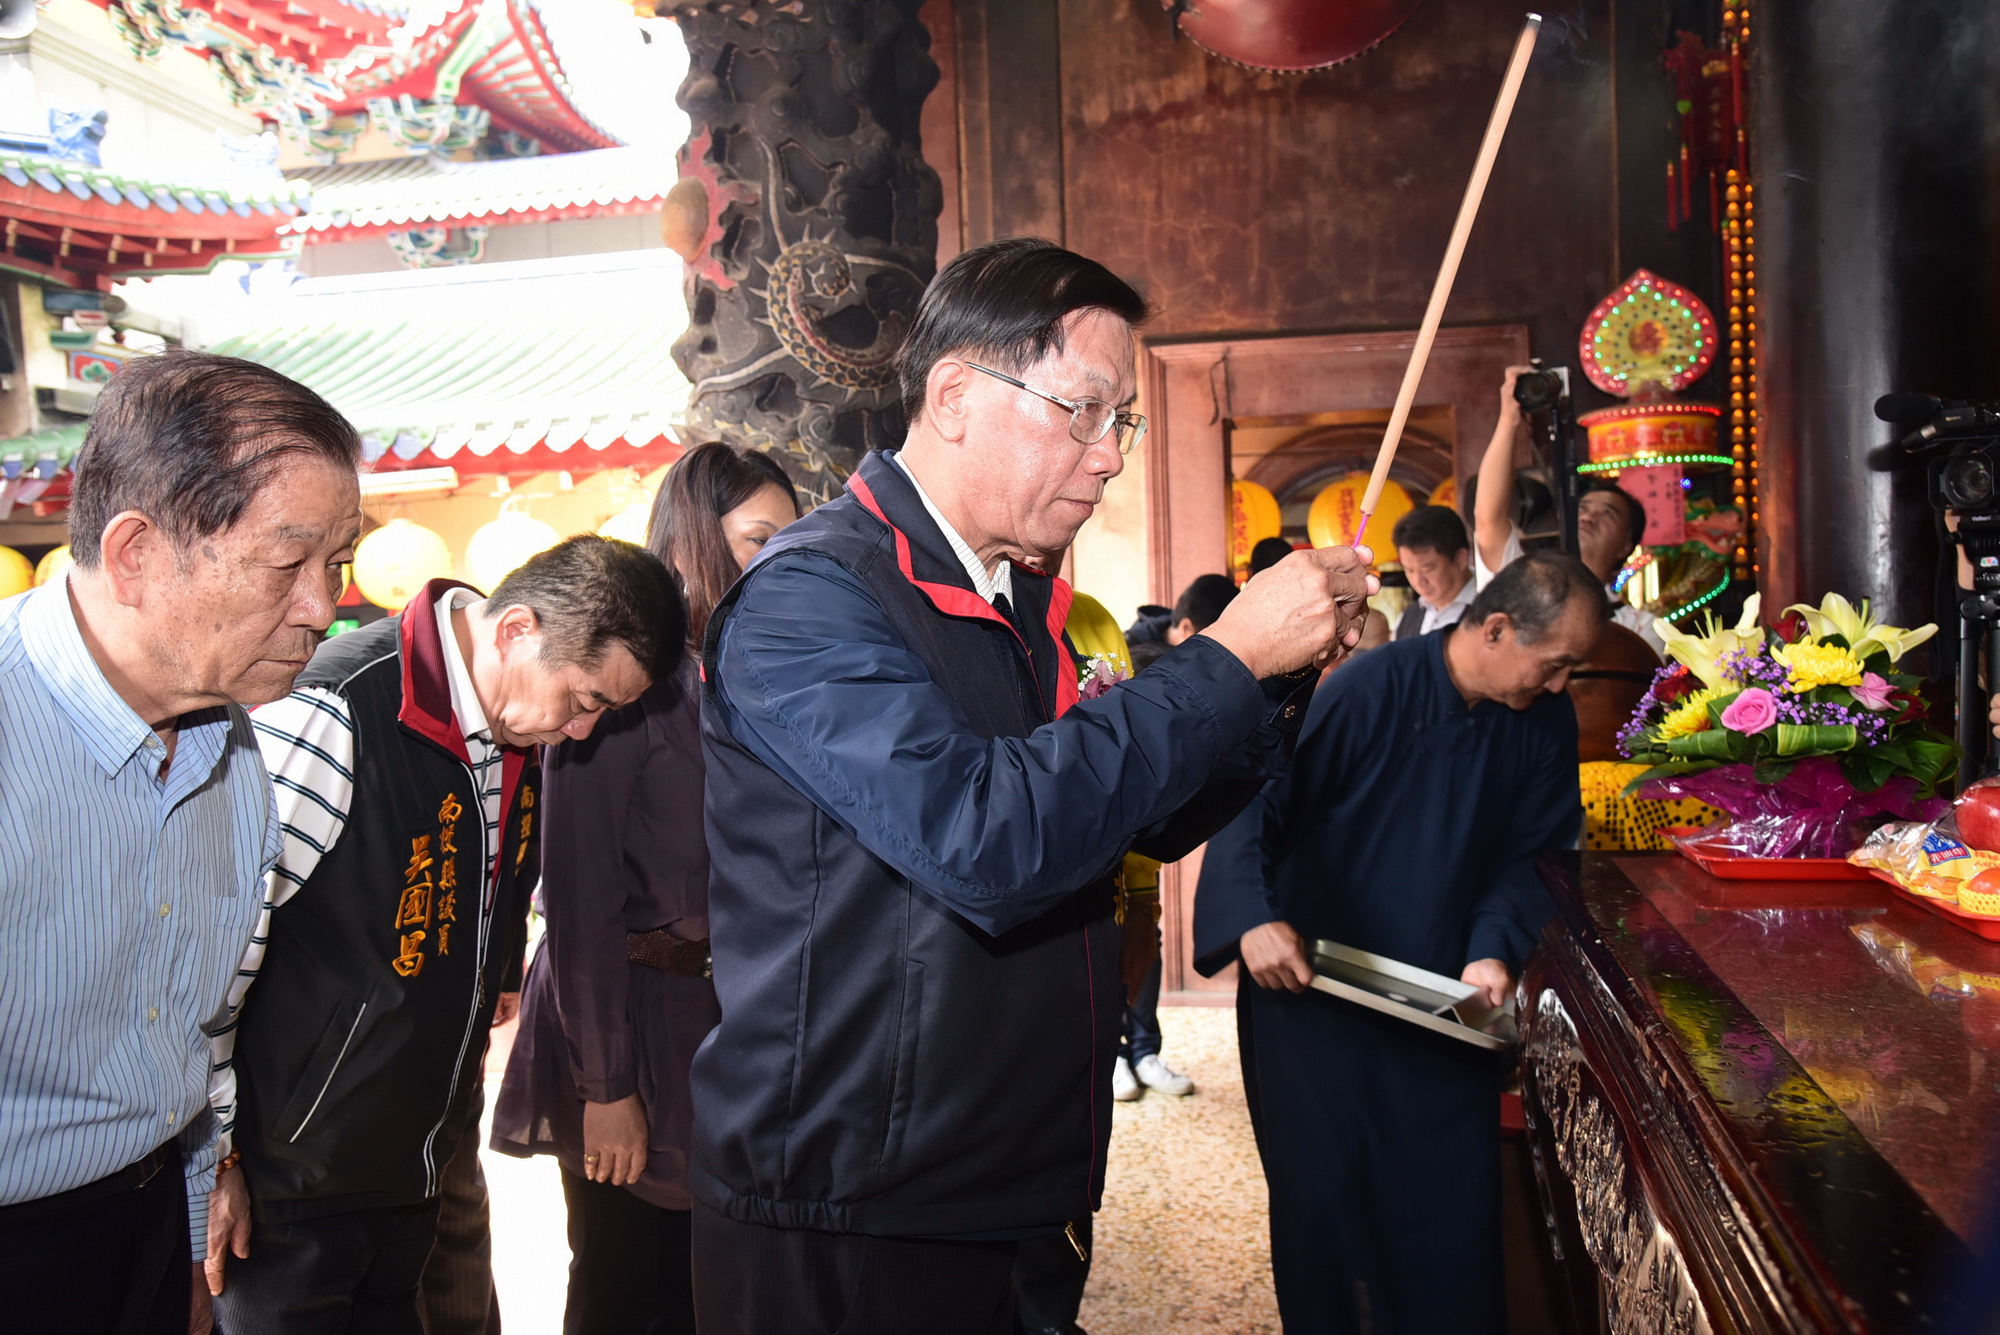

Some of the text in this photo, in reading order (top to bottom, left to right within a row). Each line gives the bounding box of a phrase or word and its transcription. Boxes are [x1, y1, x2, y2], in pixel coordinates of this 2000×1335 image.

[392, 833, 434, 977] 吳國昌
[438, 792, 463, 957] 南投縣議員
